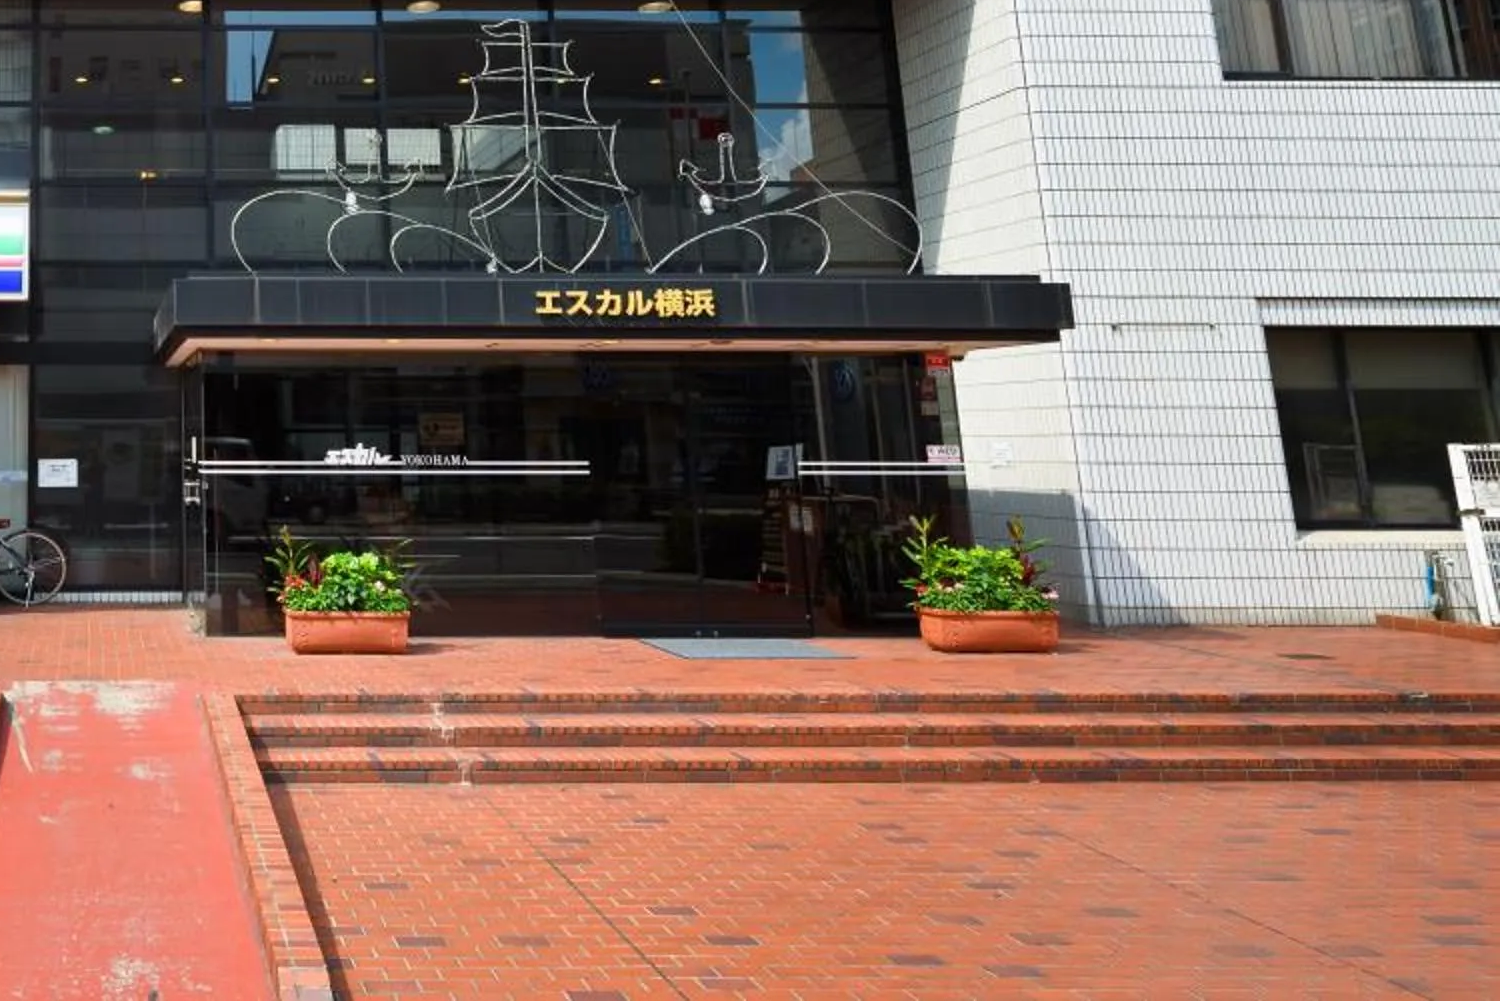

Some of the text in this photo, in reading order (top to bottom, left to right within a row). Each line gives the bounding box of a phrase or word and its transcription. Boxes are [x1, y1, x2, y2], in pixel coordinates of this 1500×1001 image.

[535, 288, 716, 318] エスカル横浜
[400, 454, 470, 466] YOKOHAMA
